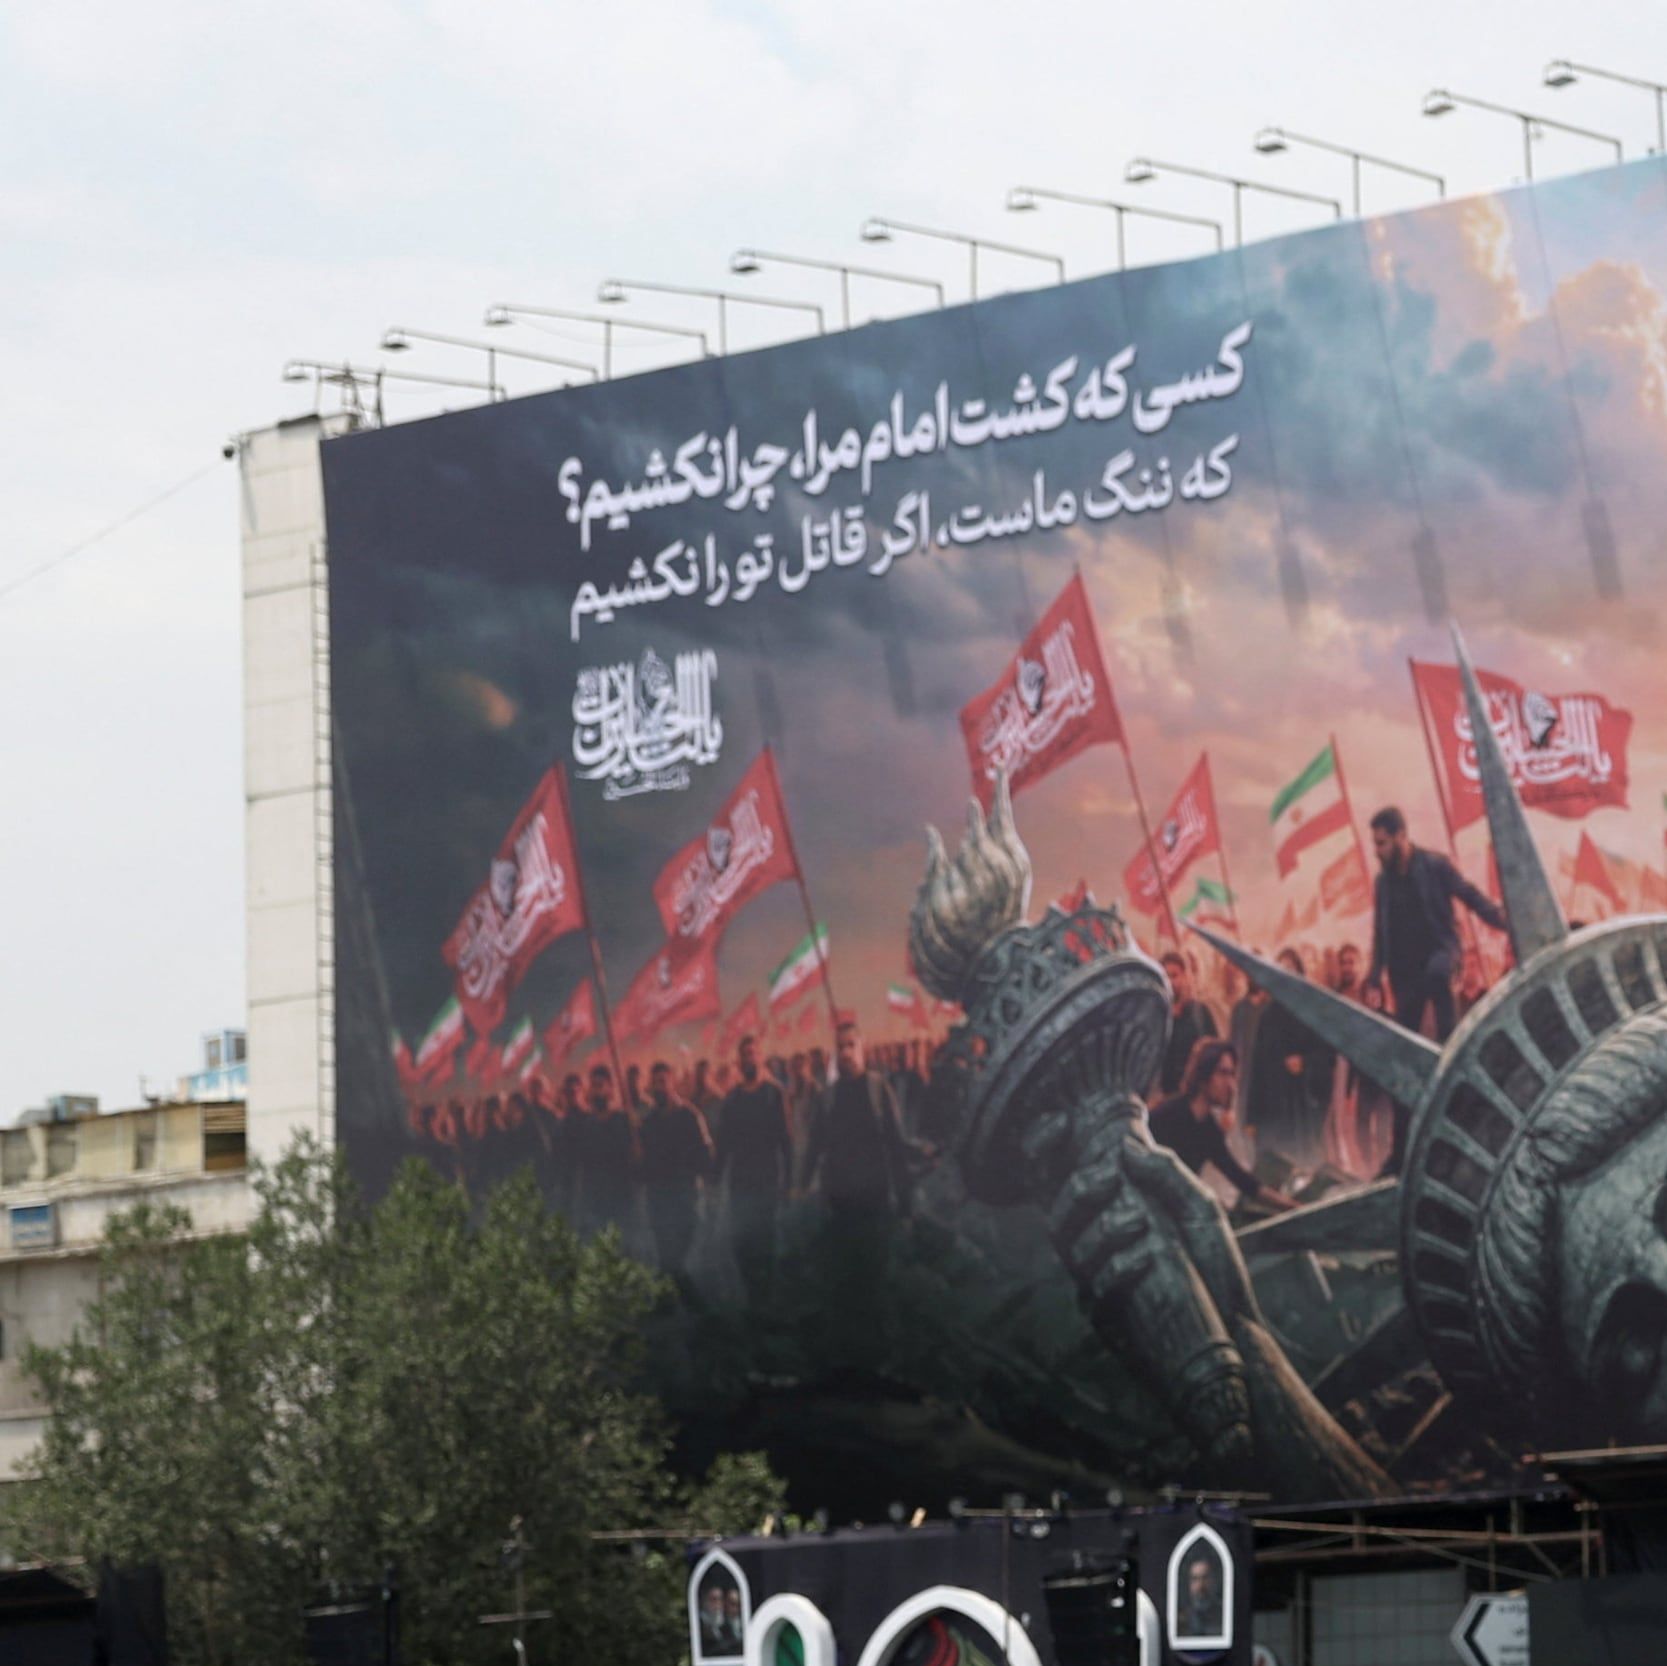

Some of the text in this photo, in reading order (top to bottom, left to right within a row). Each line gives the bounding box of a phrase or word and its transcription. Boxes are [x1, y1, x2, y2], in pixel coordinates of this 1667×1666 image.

[950, 355, 1079, 446] کشت
[1073, 344, 1138, 420] که
[1133, 320, 1253, 433] کسی
[724, 424, 789, 513] چرا
[860, 378, 949, 496] امام
[1181, 433, 1240, 500] که
[1083, 449, 1174, 521] ننگ
[703, 530, 731, 607] را
[731, 532, 775, 602] تو
[778, 503, 868, 593] قاتل
[867, 490, 930, 577] اگر
[568, 538, 702, 644] نکشیم
